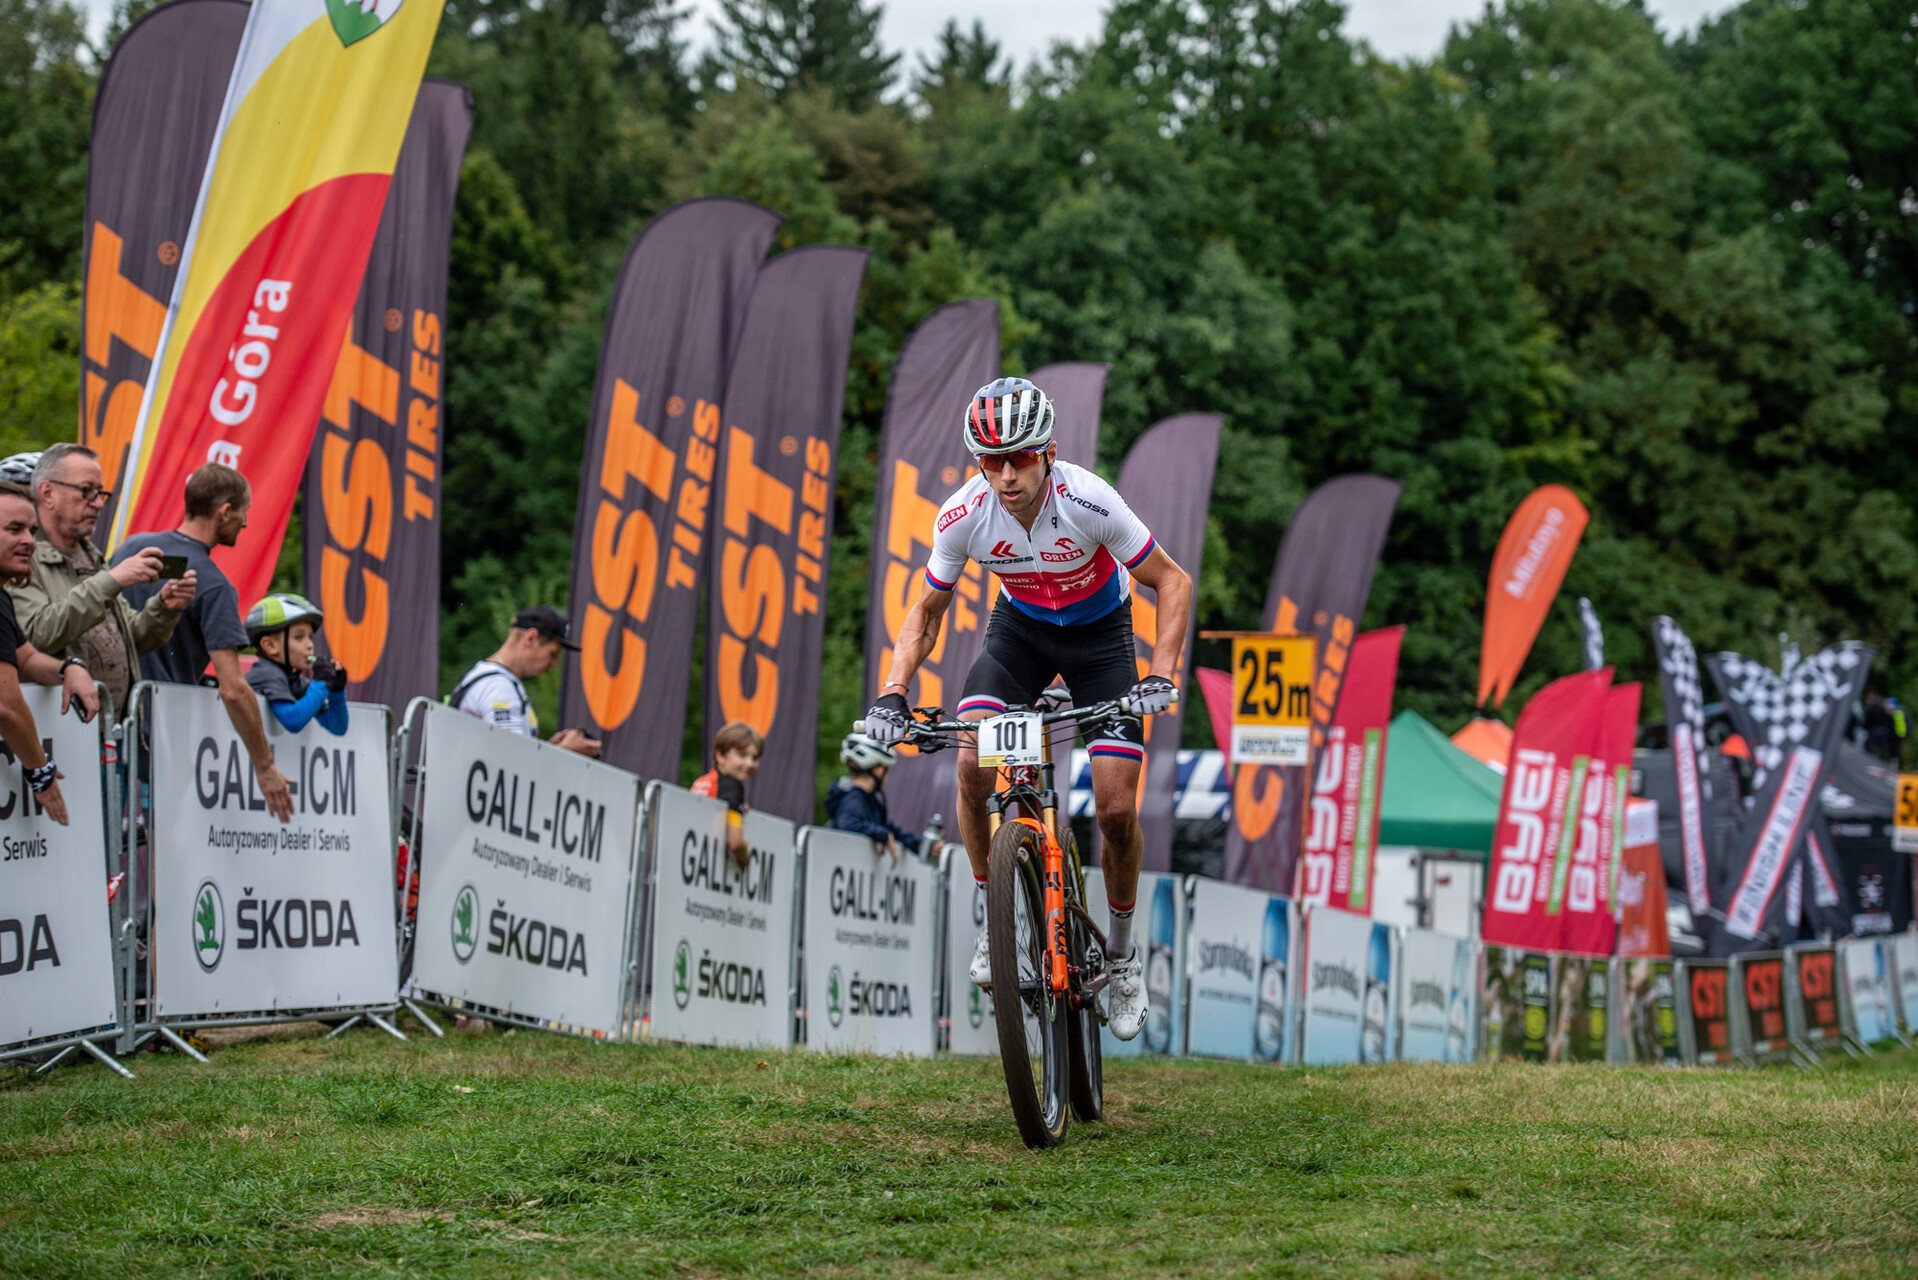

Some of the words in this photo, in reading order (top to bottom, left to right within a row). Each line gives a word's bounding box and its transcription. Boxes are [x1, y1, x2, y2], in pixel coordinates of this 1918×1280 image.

[208, 278, 293, 427] Góra
[403, 307, 442, 522] TIRES
[320, 316, 400, 684] CST
[666, 399, 720, 590] TIRES
[937, 505, 967, 532] ORLEN
[1065, 492, 1110, 518] KROSS
[581, 377, 677, 732] CST
[792, 436, 831, 616] TIRES
[1042, 549, 1083, 562] ORLEN
[718, 424, 795, 738] CST
[978, 555, 1034, 565] KROSS
[992, 720, 1029, 752] 101
[195, 736, 357, 816] GAL-ICM
[208, 824, 279, 855] Autoryzowany
[280, 826, 312, 850] Dealer
[313, 827, 317, 850] i
[318, 828, 350, 852] Serwis
[465, 759, 606, 863] GALL-ICM
[3, 832, 48, 862] Serwis
[531, 856, 558, 882] Dealer
[564, 865, 592, 893] Serwis
[236, 887, 360, 950] ŠKODA
[829, 864, 917, 926] GALL-ICM
[487, 899, 589, 977] ŠKODA
[698, 949, 767, 1007] ŠKODA
[848, 970, 912, 1019] ŠKODA
